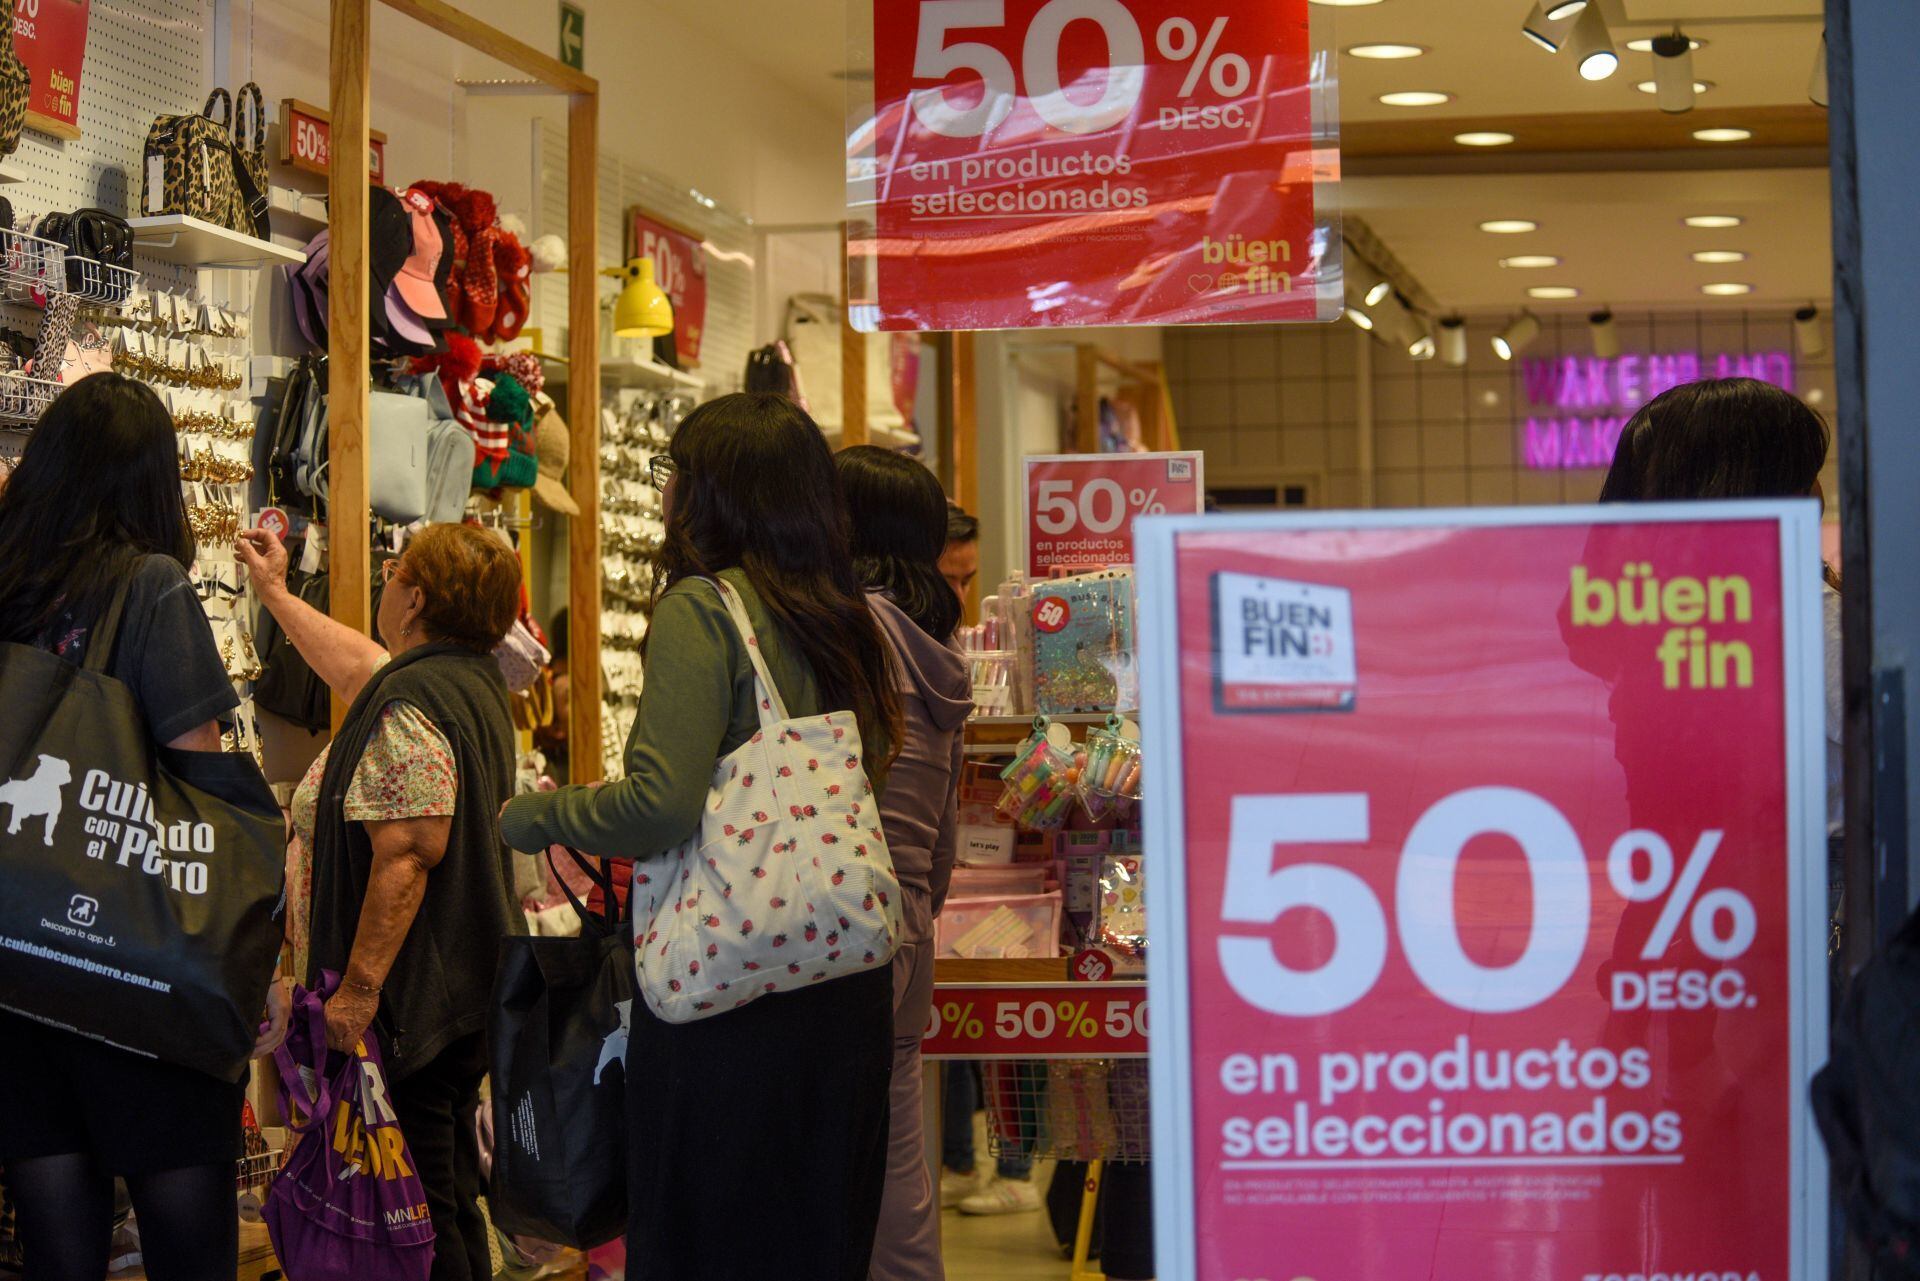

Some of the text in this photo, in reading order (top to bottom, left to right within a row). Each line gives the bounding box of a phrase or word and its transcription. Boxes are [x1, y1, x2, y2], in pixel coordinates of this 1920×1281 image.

[50, 68, 74, 95] büen
[910, 0, 1250, 137] 50%
[59, 94, 72, 117] fin
[1160, 106, 1252, 131] DESC.
[911, 151, 1131, 186] en productos
[911, 182, 1149, 214] seleccionados
[1203, 234, 1291, 264] büen
[1244, 265, 1291, 294] fin
[1524, 416, 1630, 469] MAK
[1036, 478, 1166, 534] 50%
[1036, 539, 1124, 552] en productos
[1036, 551, 1130, 563] seleccionados
[1571, 562, 1751, 626] büen
[1242, 598, 1331, 628] BUEN
[1656, 627, 1754, 689] fin
[84, 816, 120, 844] con
[86, 840, 107, 860] el
[115, 824, 208, 895] Pero
[1217, 786, 1757, 1017] 50%
[41, 918, 104, 944] Descarga la app
[1612, 970, 1757, 1010] DESC.
[995, 1001, 1099, 1039] 50%
[1220, 1035, 1651, 1105] en productos
[1222, 1097, 1682, 1156] seleccionados
